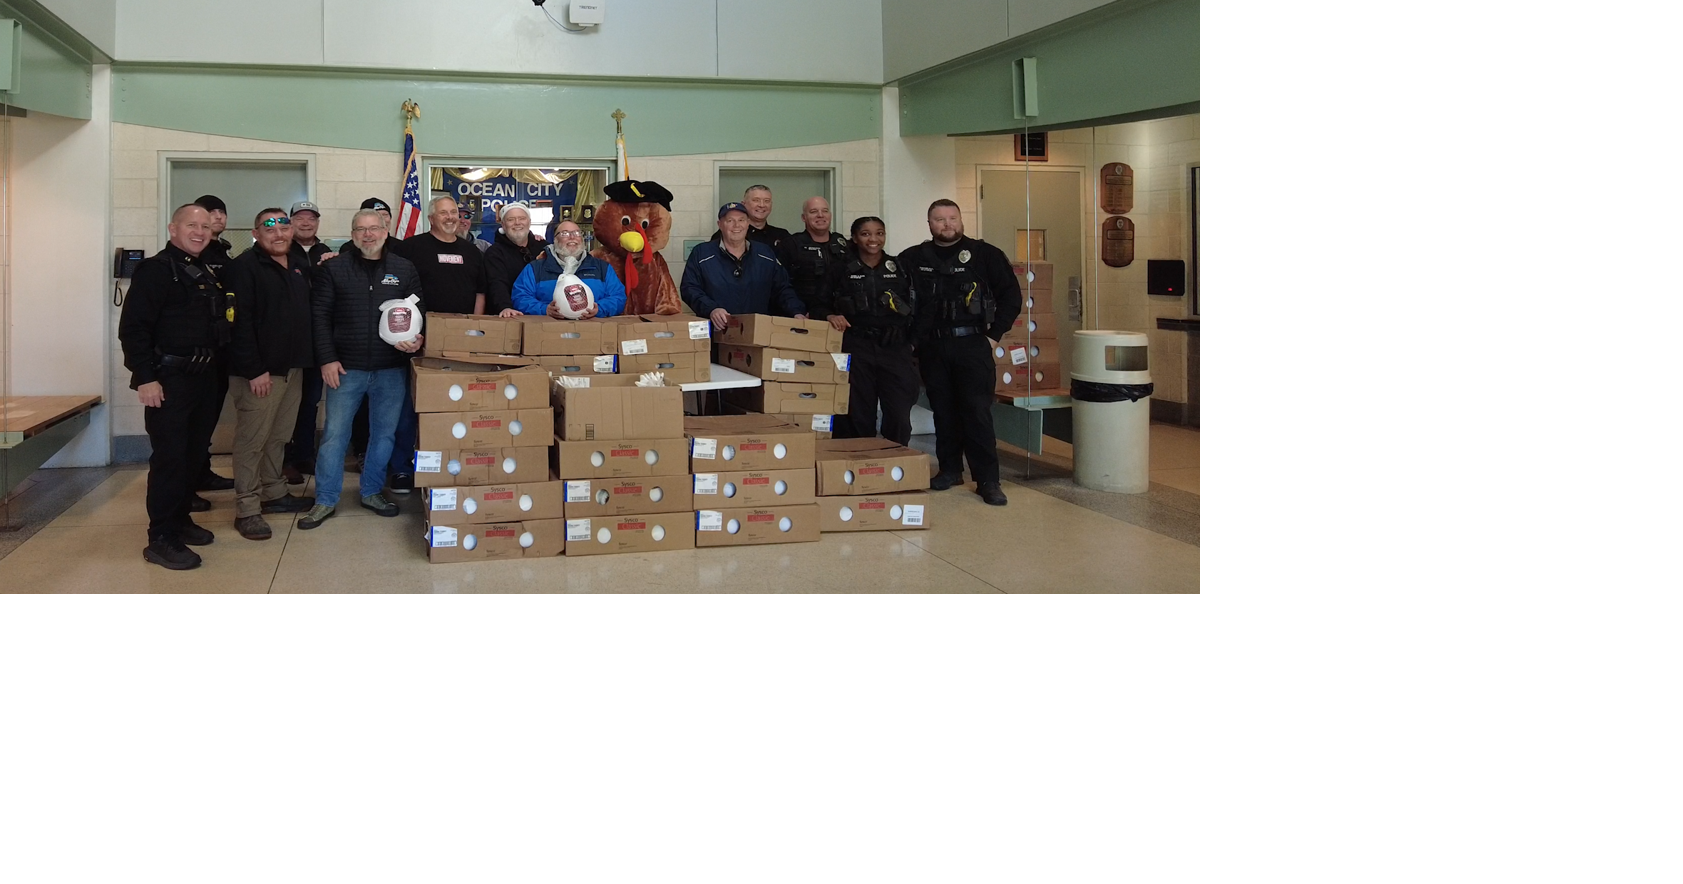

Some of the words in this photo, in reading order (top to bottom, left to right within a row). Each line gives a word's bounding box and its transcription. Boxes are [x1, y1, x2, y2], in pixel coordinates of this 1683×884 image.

[458, 182, 515, 197] OCEAN
[527, 183, 563, 196] CITY
[481, 199, 537, 212] POCE
